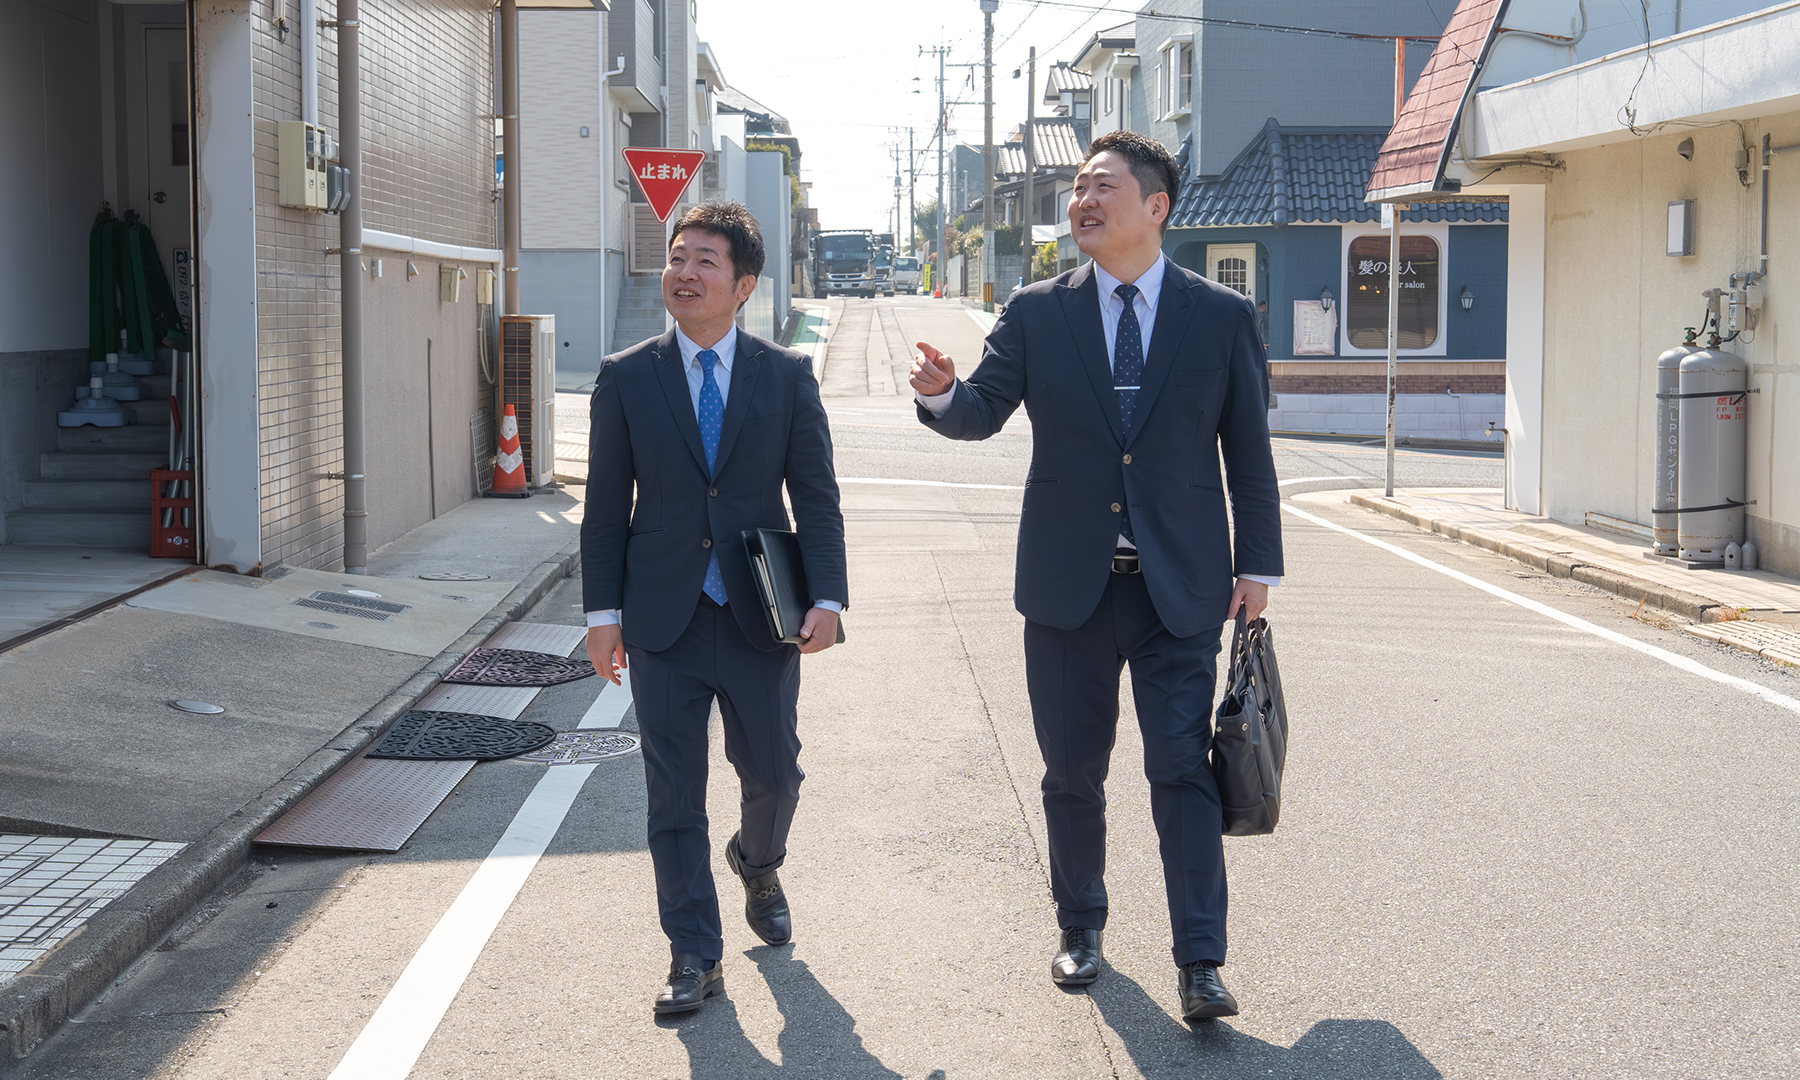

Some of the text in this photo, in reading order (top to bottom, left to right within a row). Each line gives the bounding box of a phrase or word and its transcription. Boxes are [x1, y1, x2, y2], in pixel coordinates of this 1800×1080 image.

[639, 162, 688, 180] 止まれ
[1404, 280, 1425, 289] salon
